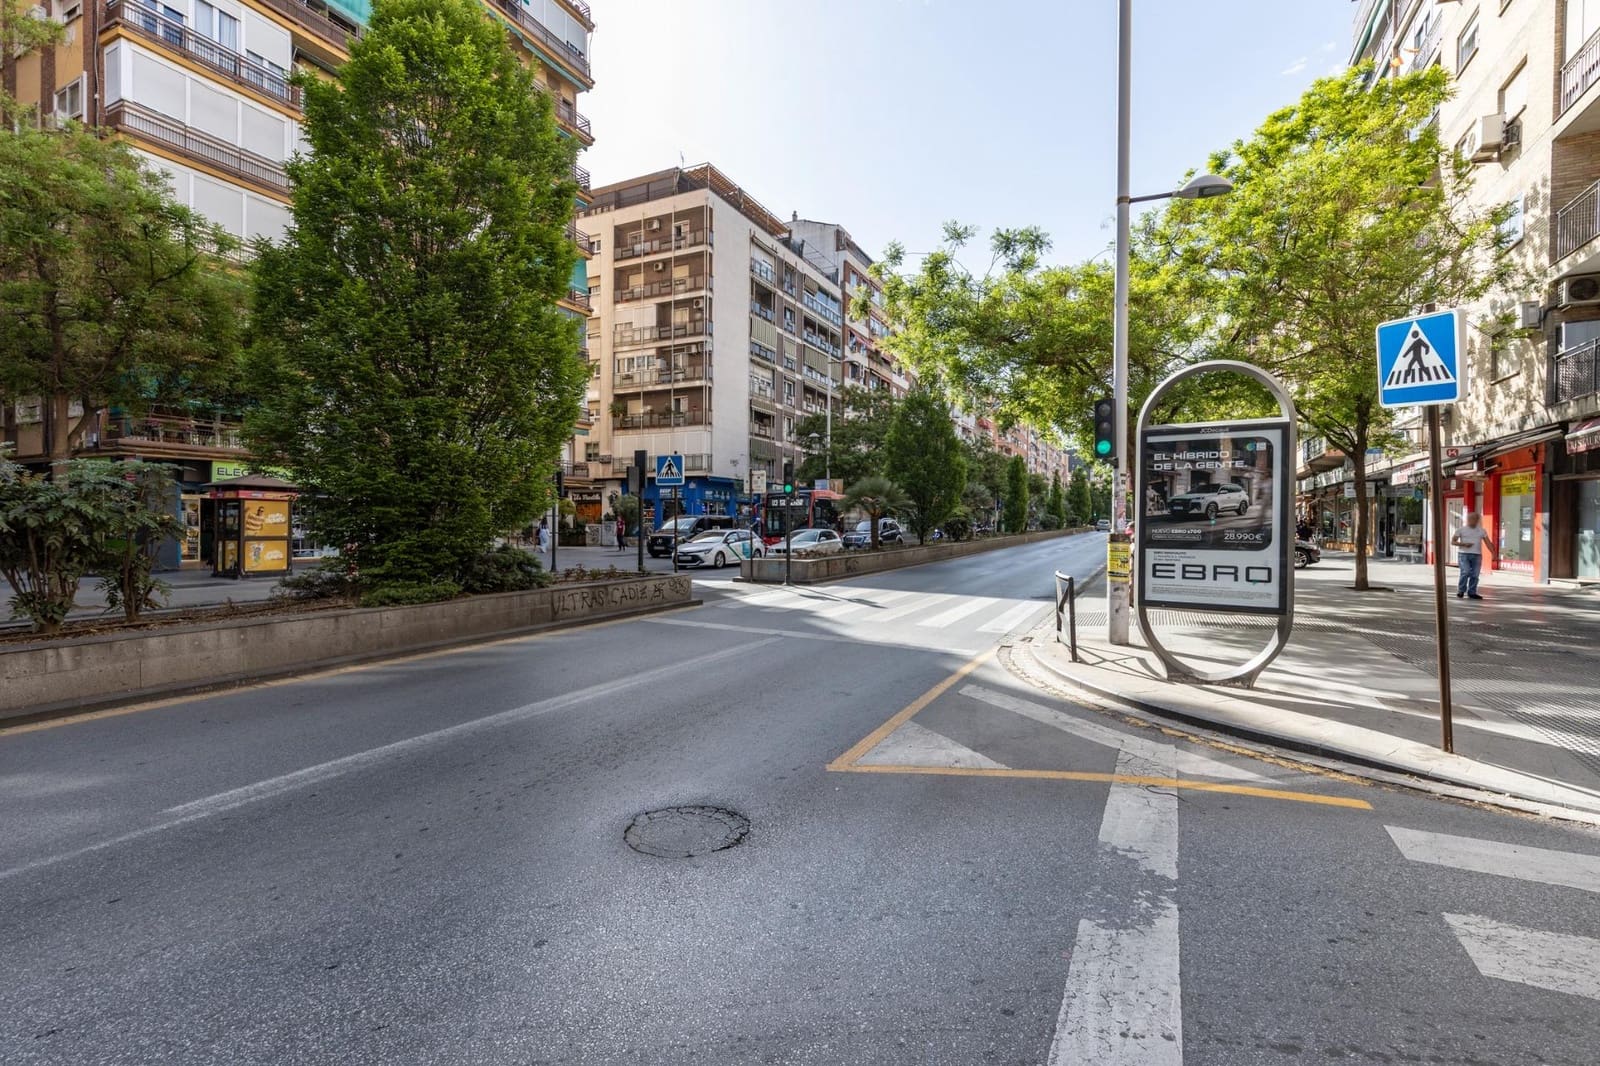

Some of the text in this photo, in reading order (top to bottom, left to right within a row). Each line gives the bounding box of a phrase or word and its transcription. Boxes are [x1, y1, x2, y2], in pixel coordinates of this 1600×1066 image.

[1153, 450, 1230, 461] EL HÍBRIDO
[1153, 460, 1248, 471] DE LA GENTE.
[1151, 563, 1273, 584] EBRO
[551, 590, 606, 616] ULTRAS
